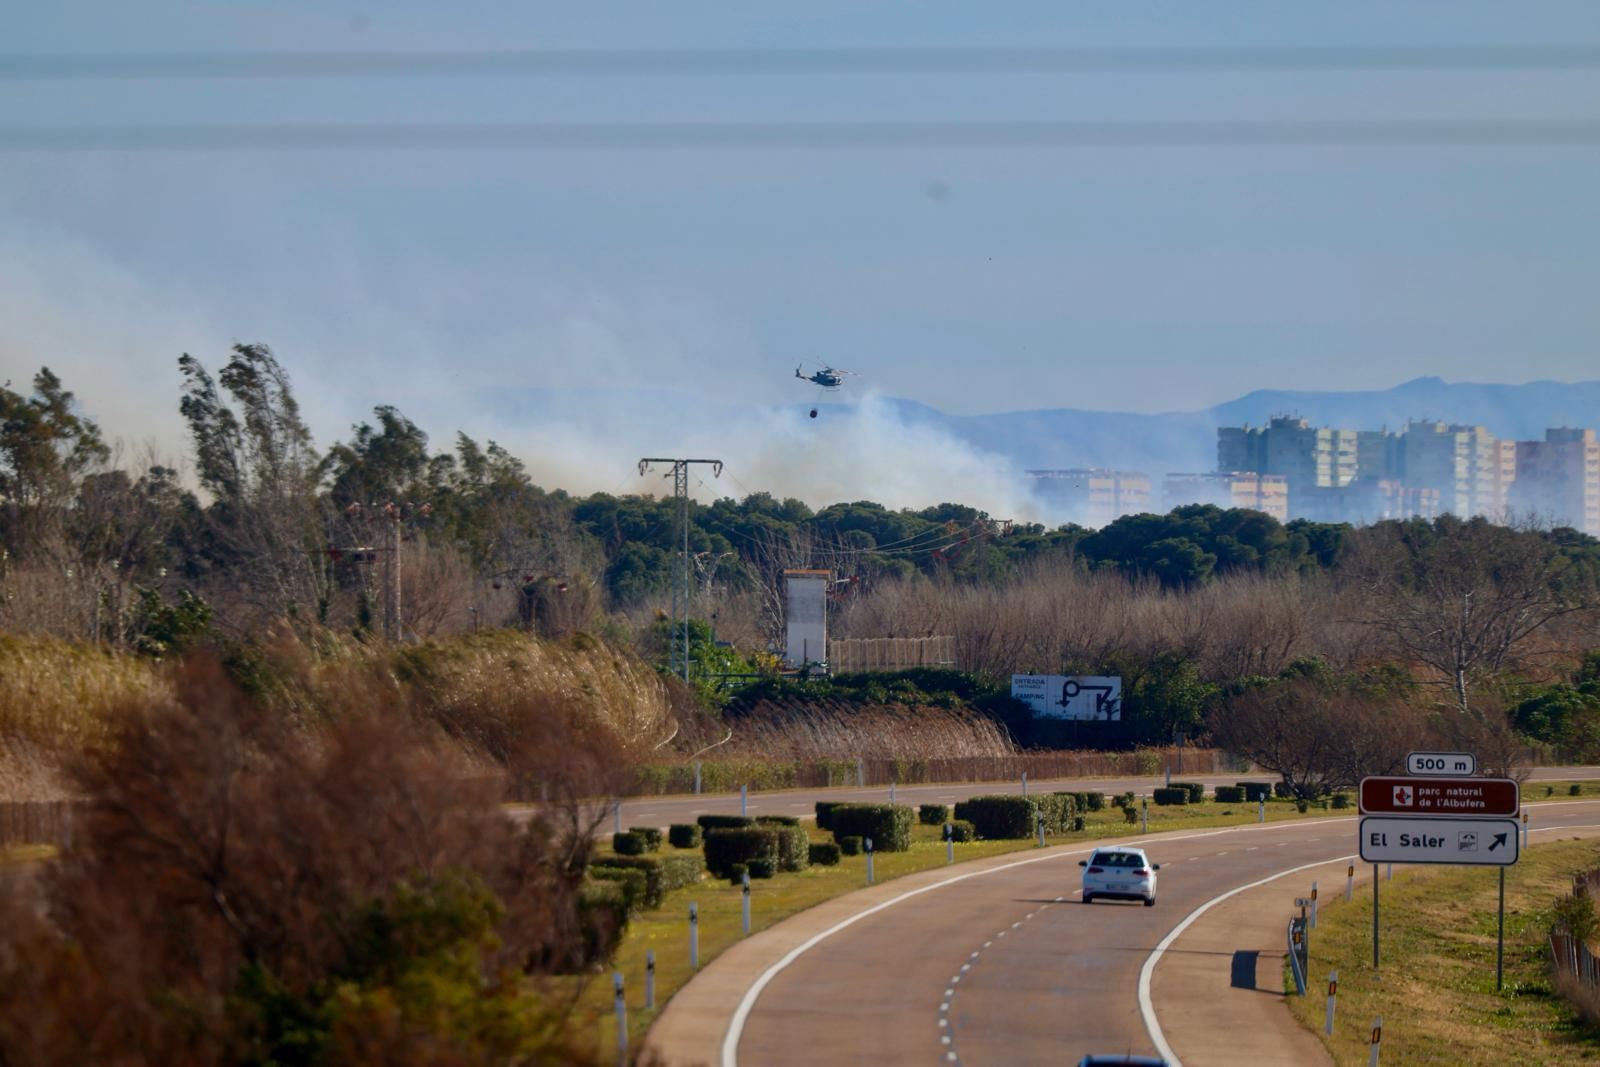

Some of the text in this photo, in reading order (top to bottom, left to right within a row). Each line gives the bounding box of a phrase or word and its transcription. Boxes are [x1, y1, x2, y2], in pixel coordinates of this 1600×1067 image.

[1416, 758, 1466, 771] 500 m
[1418, 787, 1482, 797] parc natural
[1419, 799, 1486, 808] de l'Albufera
[1370, 832, 1445, 848] El Saler
